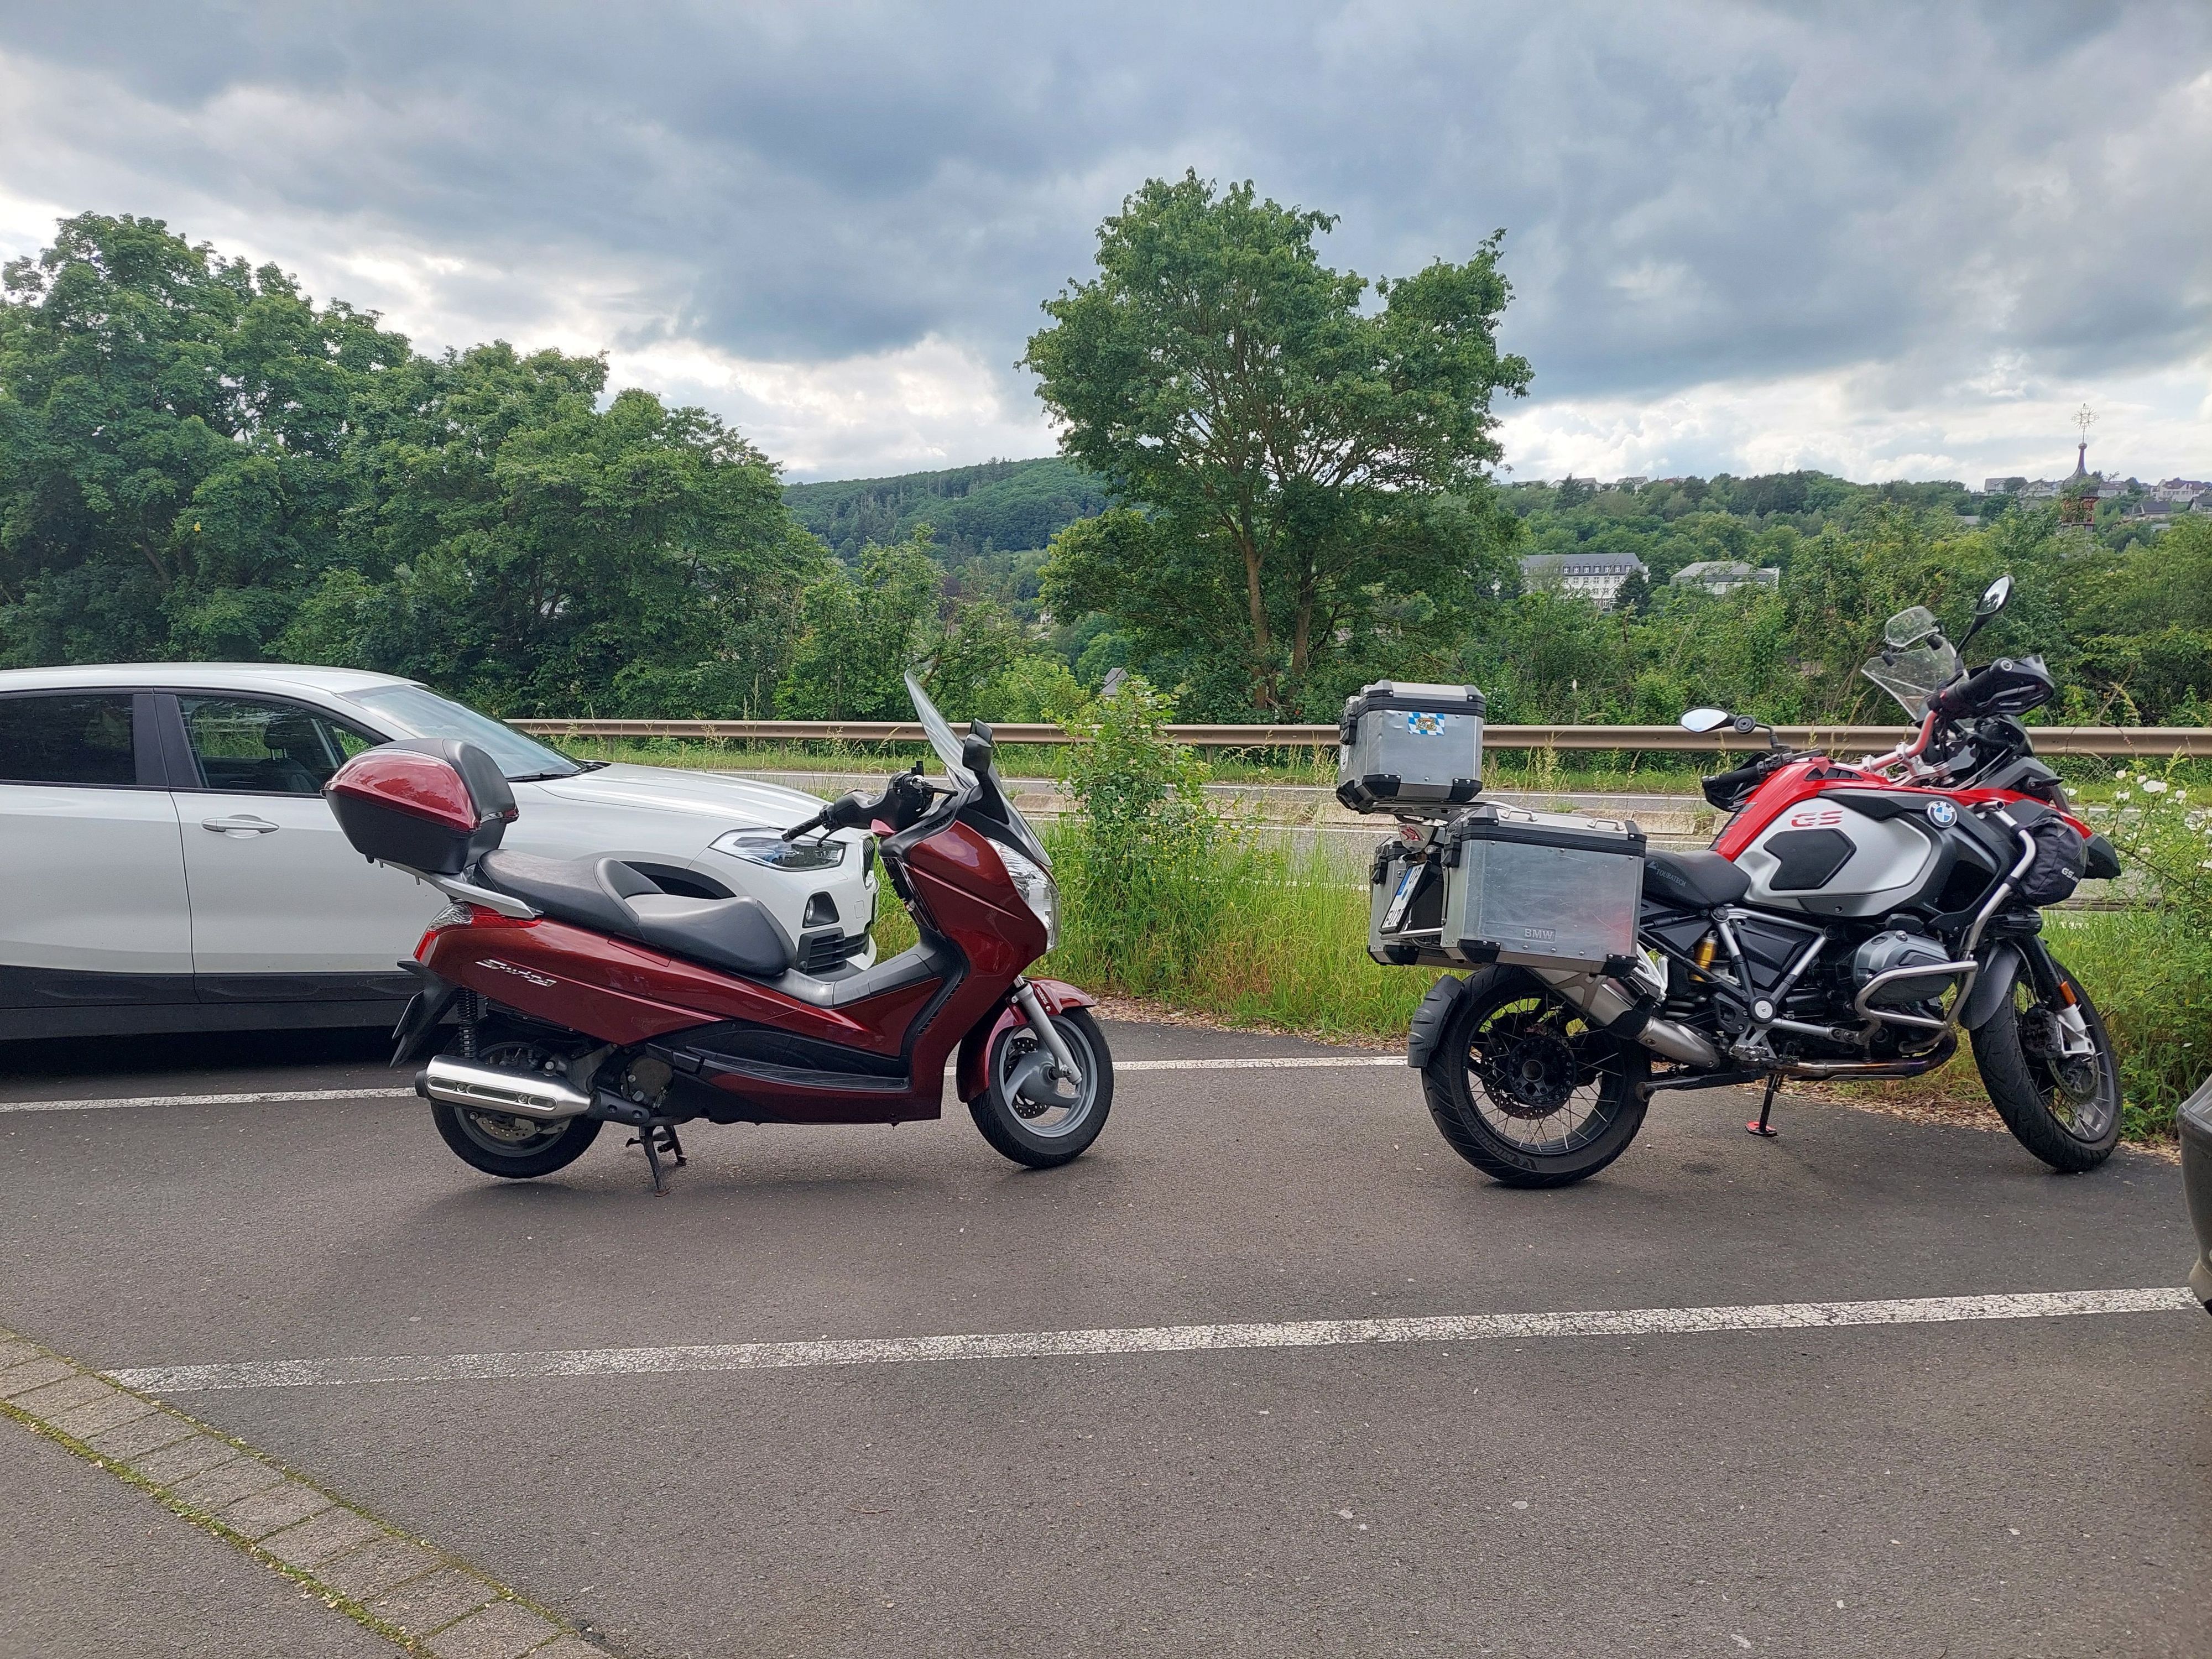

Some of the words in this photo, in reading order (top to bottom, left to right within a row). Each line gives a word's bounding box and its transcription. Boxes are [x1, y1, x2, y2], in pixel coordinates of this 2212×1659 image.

[1932, 801, 1955, 812] BMW
[1791, 811, 1843, 827] GS
[1656, 869, 1687, 887] TOURATECH
[2062, 867, 2075, 879] GS
[1524, 928, 1553, 940] BMW
